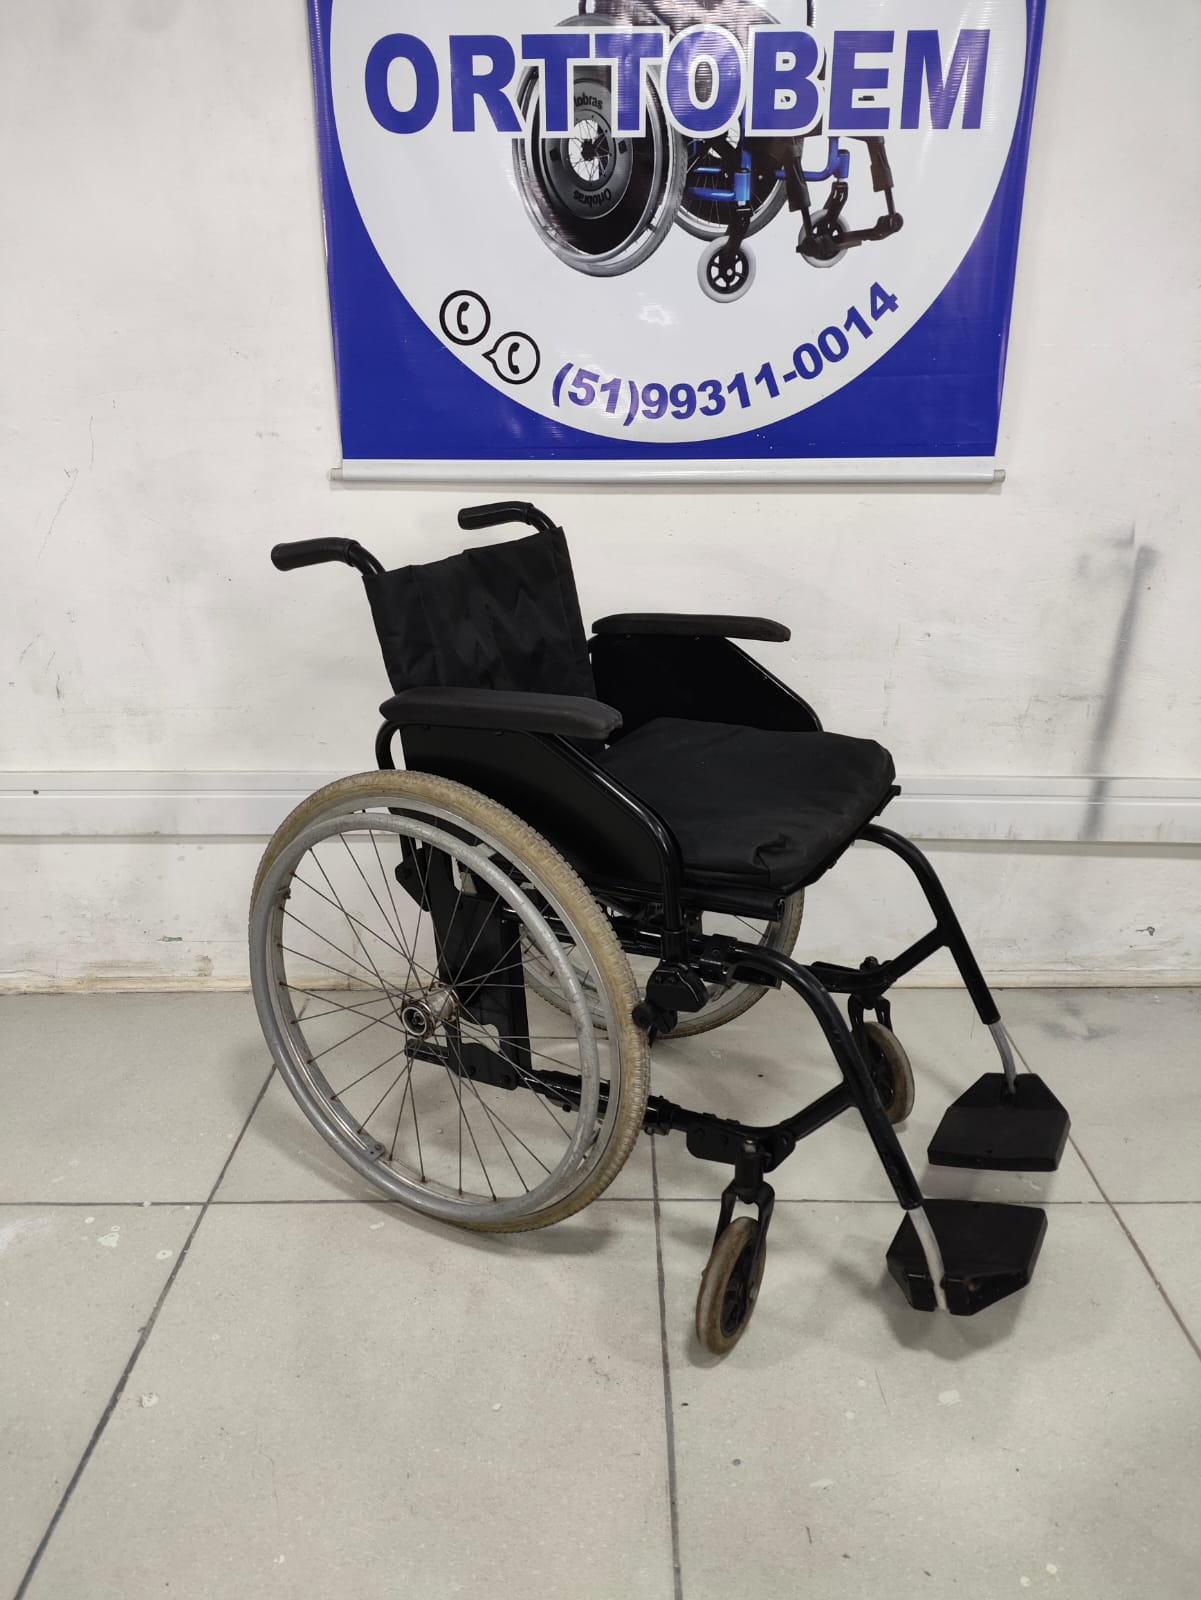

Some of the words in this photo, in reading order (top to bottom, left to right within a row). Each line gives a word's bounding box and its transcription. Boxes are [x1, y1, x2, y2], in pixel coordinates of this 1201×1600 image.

[364, 29, 990, 135] ORTTOBEM
[573, 188, 612, 208] Ortobras
[551, 281, 899, 426] (51)99311-0014
